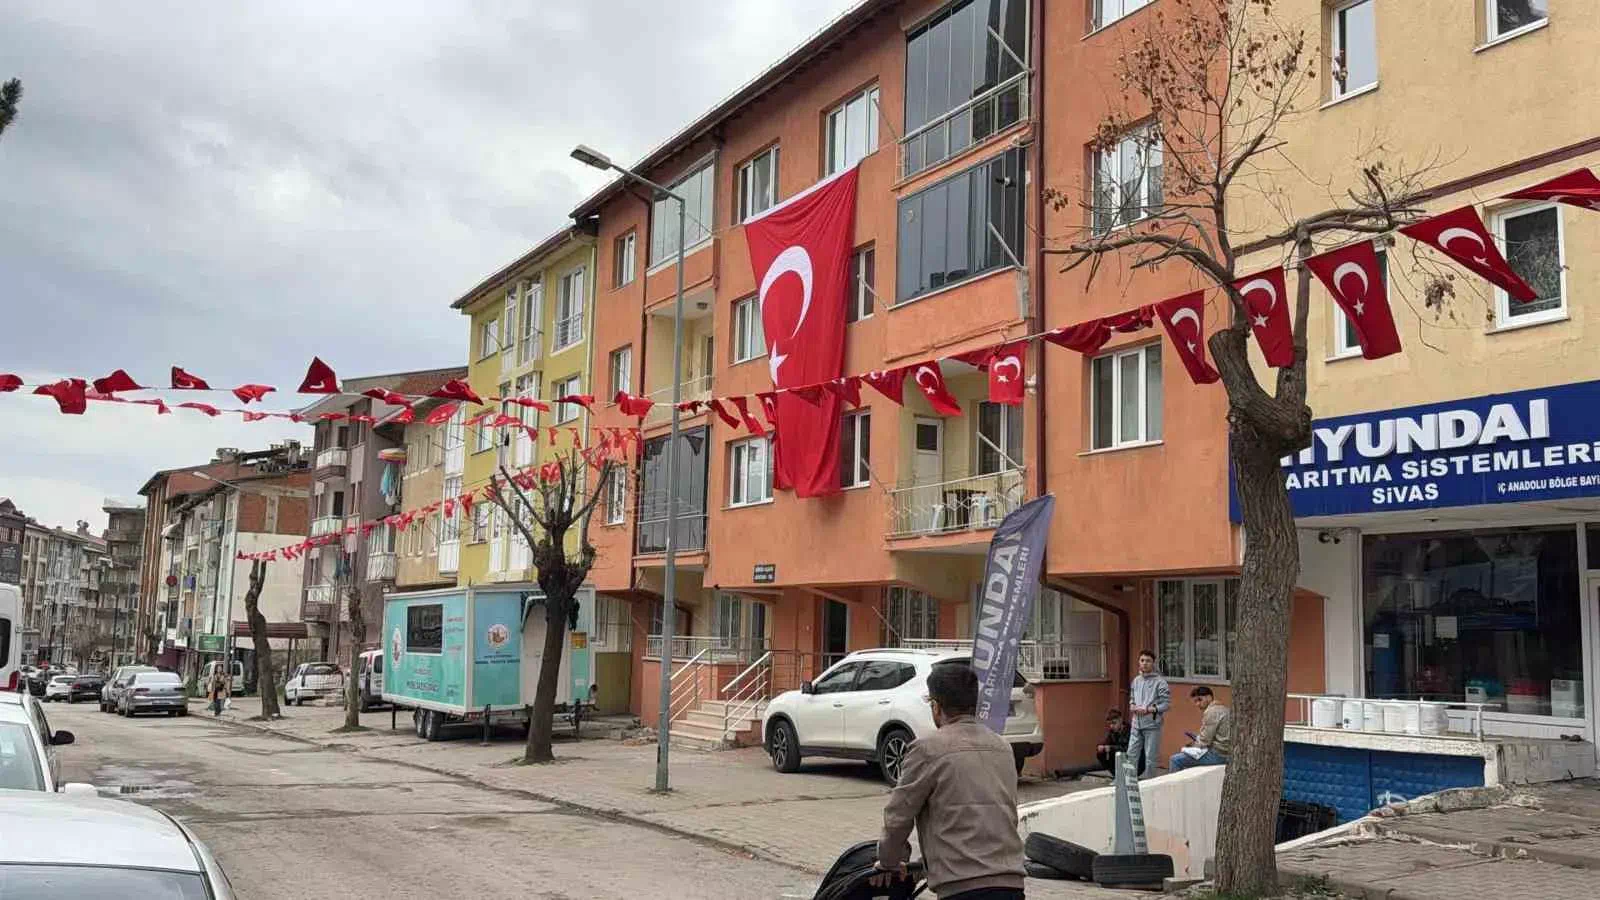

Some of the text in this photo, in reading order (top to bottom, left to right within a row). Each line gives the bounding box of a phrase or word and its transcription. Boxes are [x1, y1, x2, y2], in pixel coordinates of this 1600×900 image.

[1285, 463, 1392, 490] ARITMA
[1508, 479, 1547, 492] ANADOLU
[1549, 476, 1578, 488] BÖLGE
